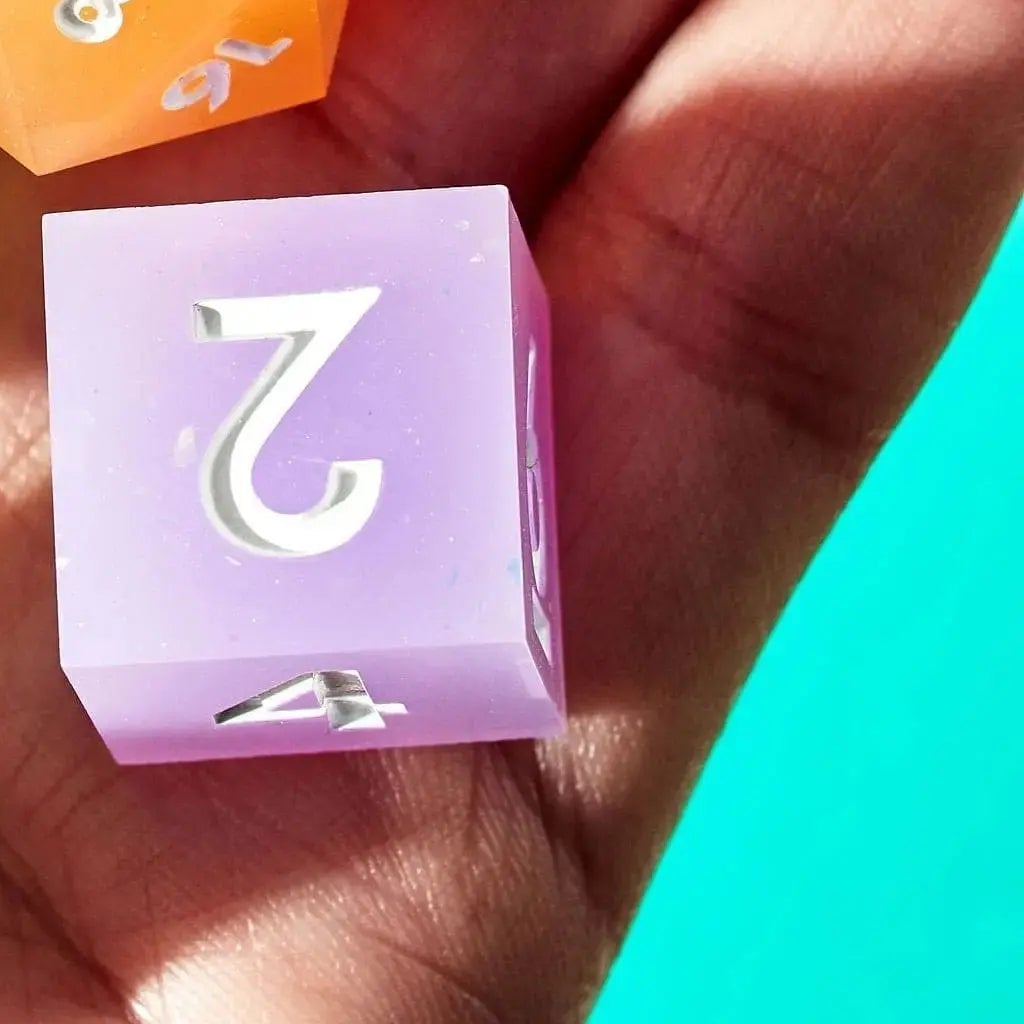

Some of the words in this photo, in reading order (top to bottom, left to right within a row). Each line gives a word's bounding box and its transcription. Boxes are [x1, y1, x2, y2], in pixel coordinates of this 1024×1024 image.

[161, 37, 293, 112] 16
[193, 286, 384, 558] 2
[213, 669, 408, 731] 4
